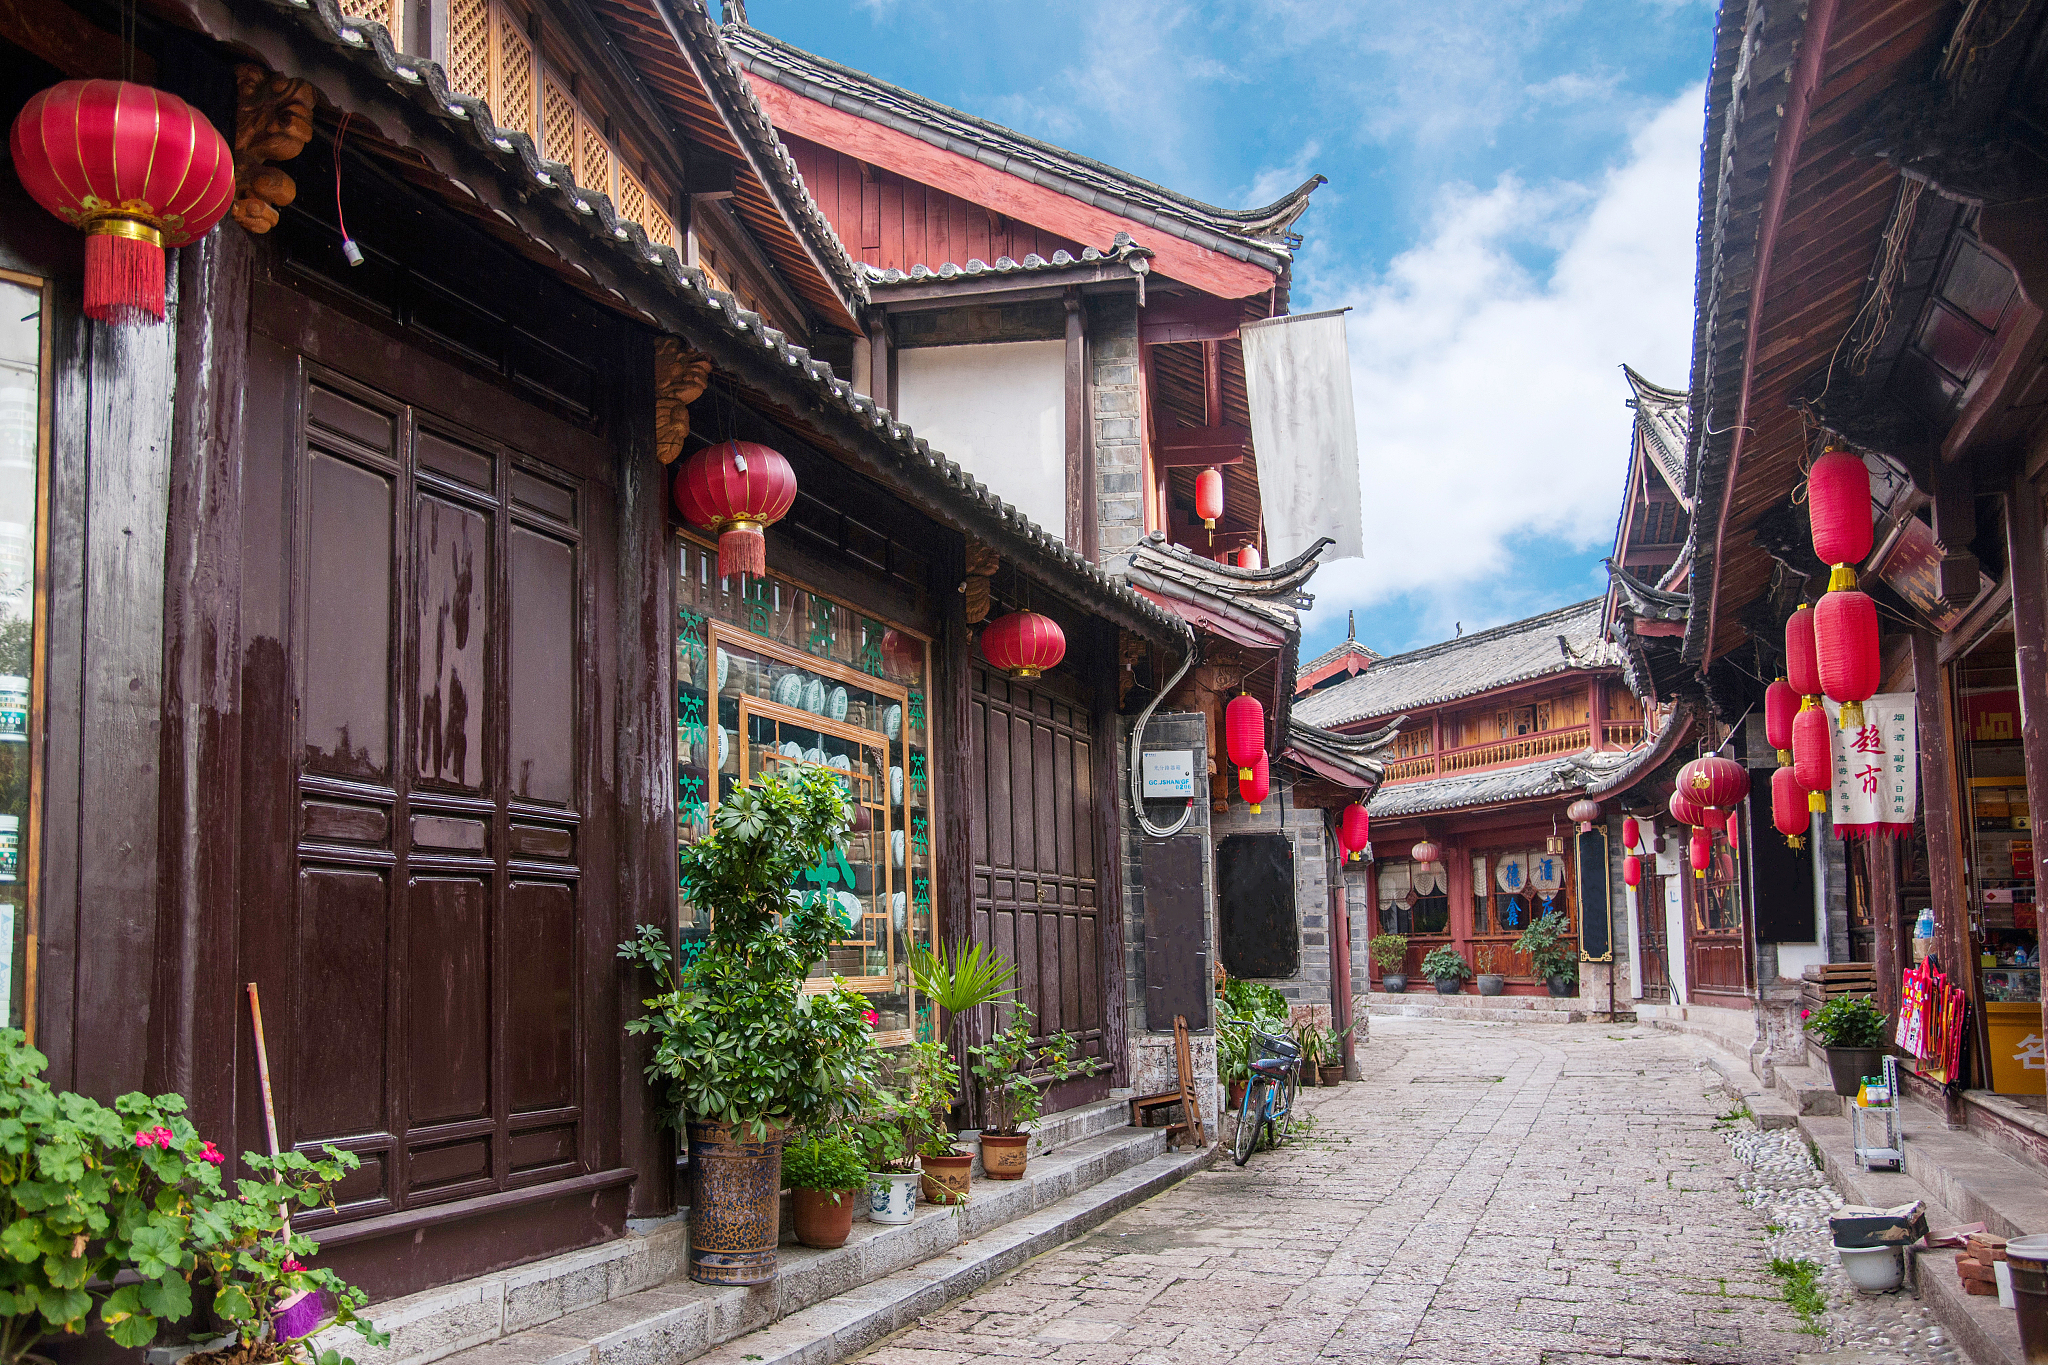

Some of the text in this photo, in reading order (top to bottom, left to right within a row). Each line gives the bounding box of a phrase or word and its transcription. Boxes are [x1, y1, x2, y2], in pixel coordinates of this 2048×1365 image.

[679, 608, 704, 660] 茶
[743, 573, 884, 678] 普洱茶
[679, 692, 705, 749] 茶
[909, 691, 925, 729] 茶
[910, 753, 926, 792] 茶
[1850, 724, 1885, 804] 超市
[679, 774, 705, 825] 茶
[912, 815, 928, 855] 茶
[914, 876, 930, 916] 茶
[2012, 1033, 2046, 1070] 名
